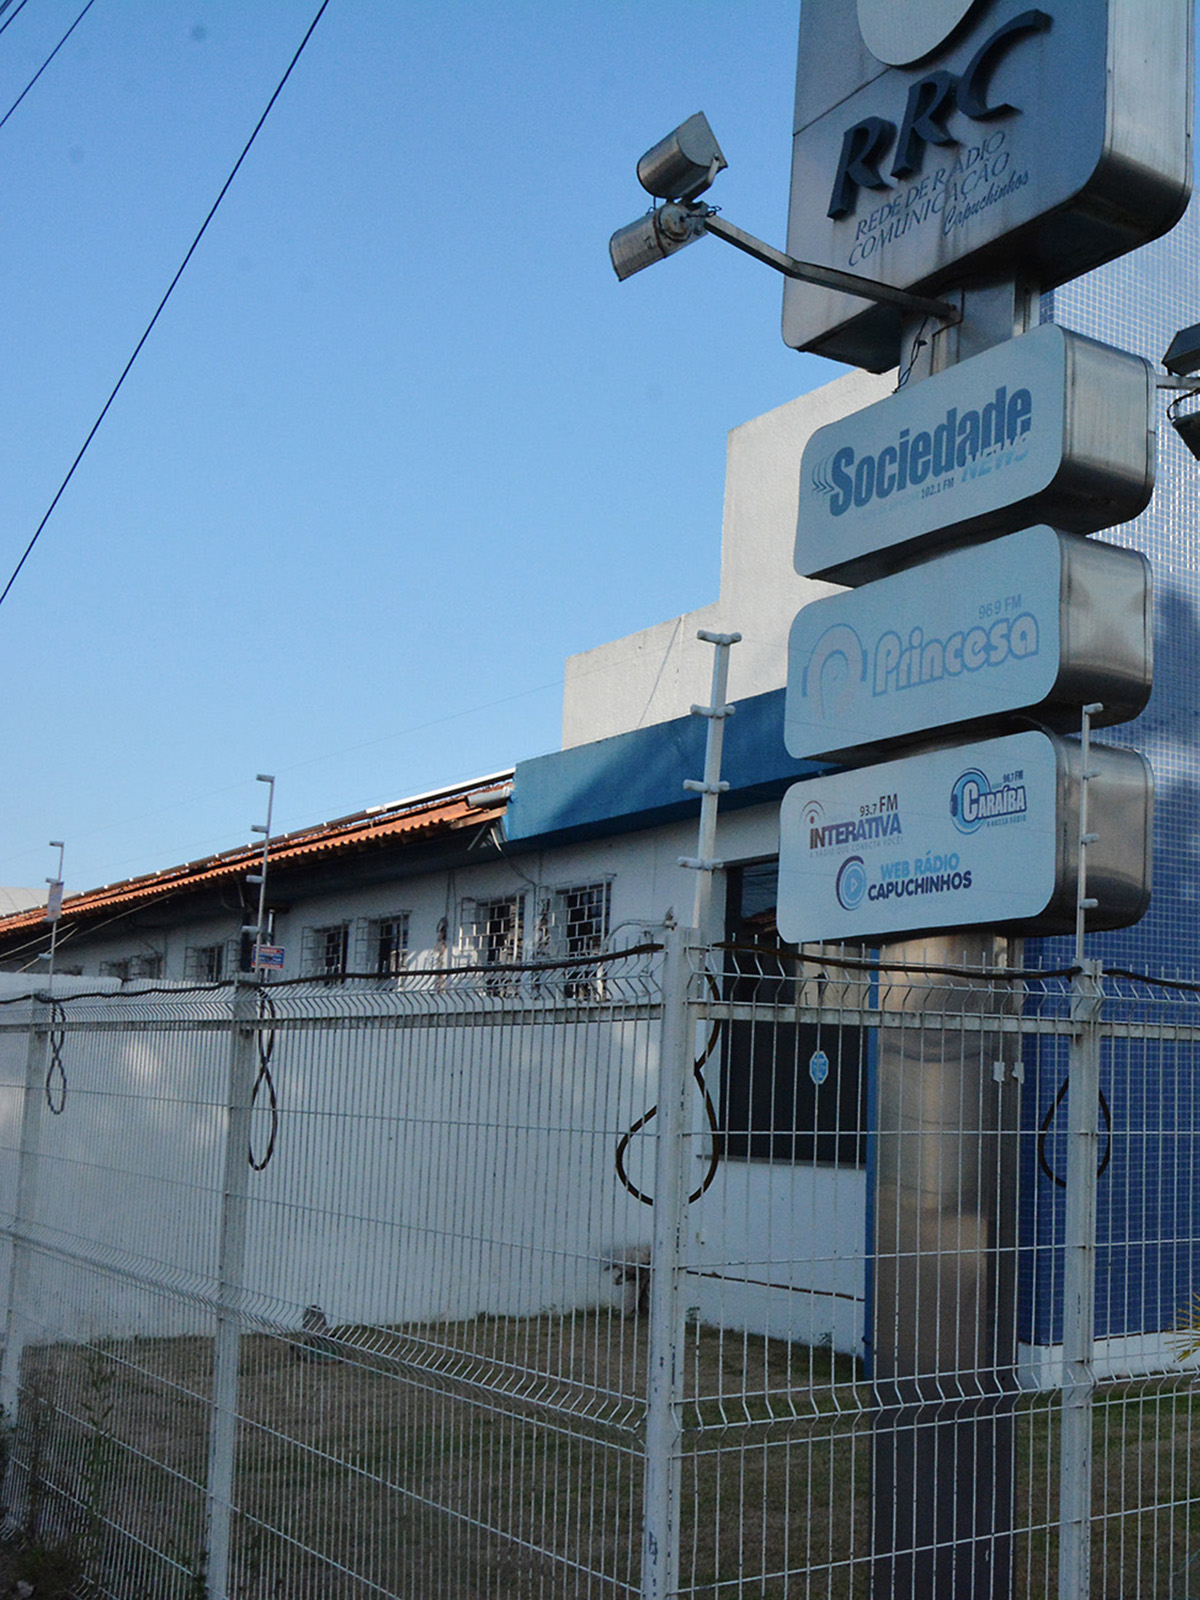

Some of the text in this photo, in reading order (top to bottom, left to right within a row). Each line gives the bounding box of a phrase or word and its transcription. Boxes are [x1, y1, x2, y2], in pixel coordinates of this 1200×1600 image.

[826, 8, 1053, 221] RRC
[848, 152, 1010, 267] COMUNICAÇÃO
[856, 193, 902, 241] REDE
[905, 176, 931, 209] DE
[943, 170, 1030, 237] Capuchinhos
[829, 385, 1032, 517] Sociedade
[921, 477, 955, 499] 102.1 FM
[1004, 593, 1022, 613] FM
[872, 611, 1039, 698] Princesa
[1015, 769, 1024, 781] FM
[859, 793, 898, 817] 93.7 FM
[809, 813, 902, 849] INTERATIVA
[881, 850, 960, 880] WEB RÁDIO
[868, 870, 972, 902] CAPUCHINHOS
